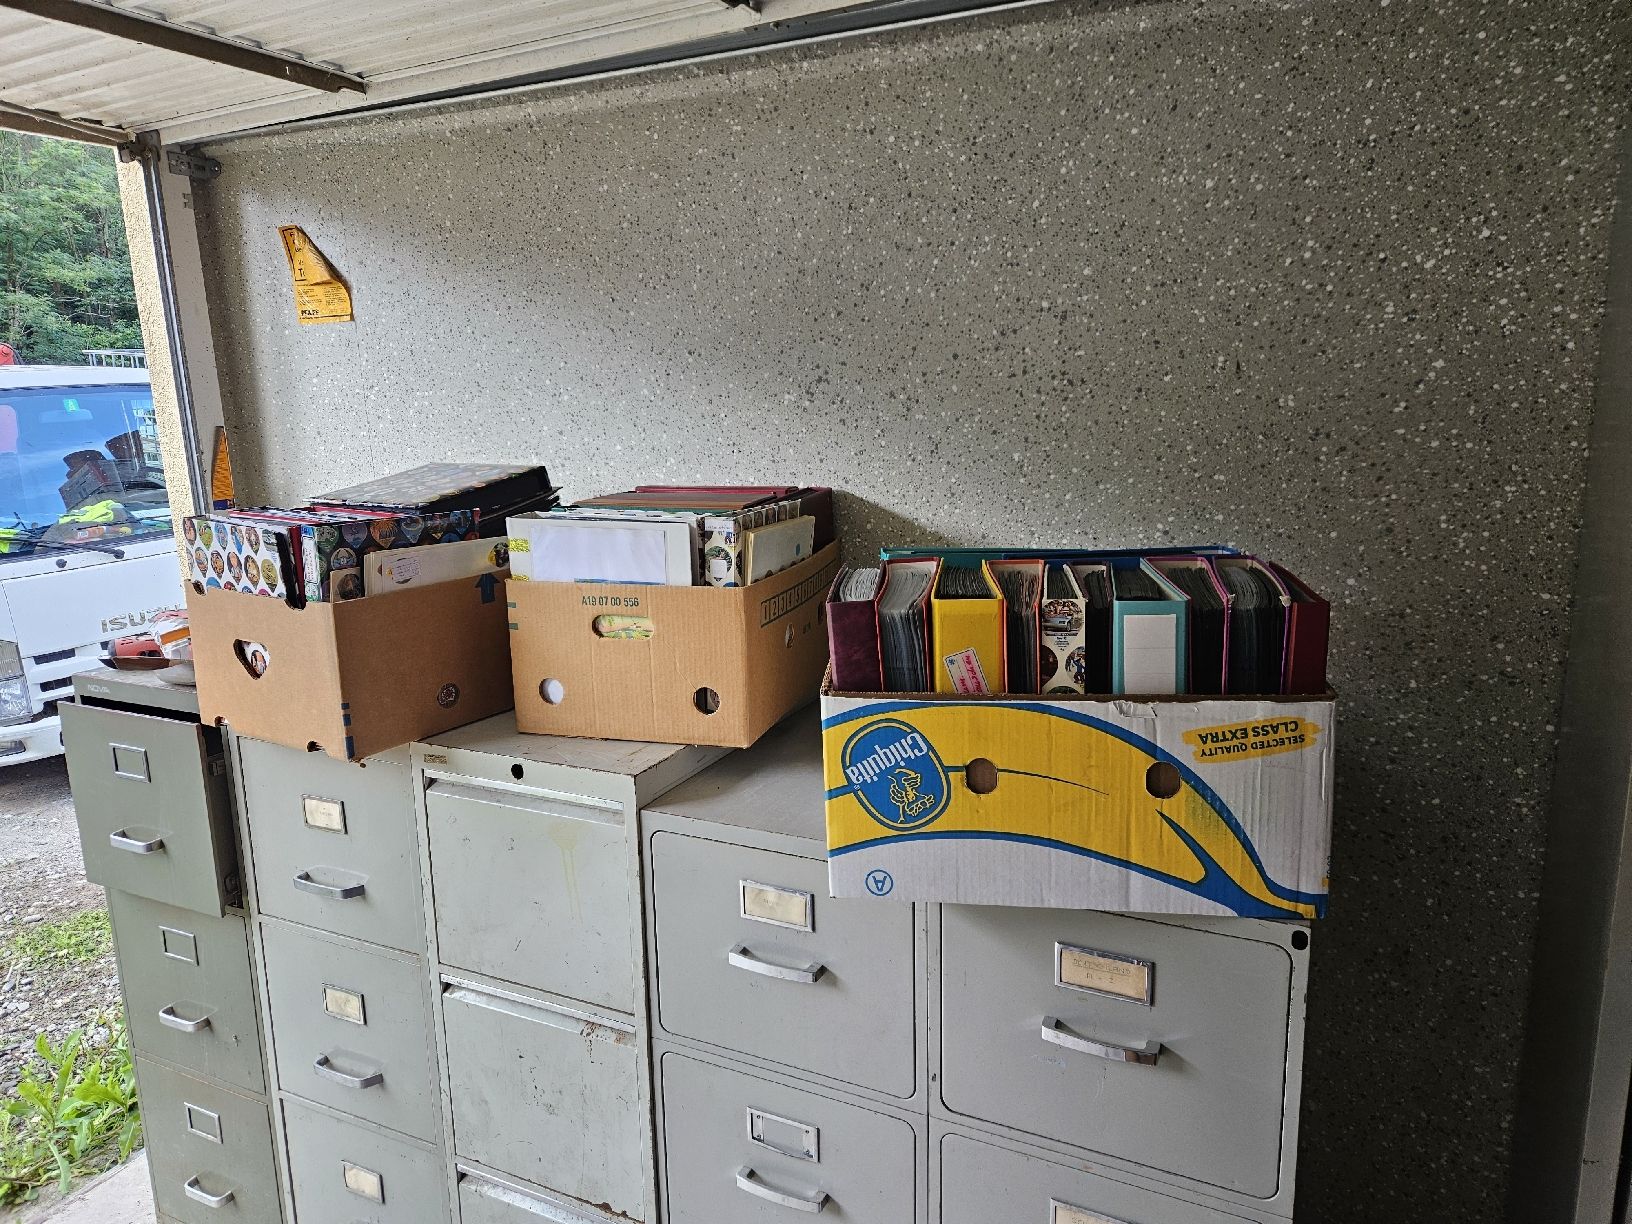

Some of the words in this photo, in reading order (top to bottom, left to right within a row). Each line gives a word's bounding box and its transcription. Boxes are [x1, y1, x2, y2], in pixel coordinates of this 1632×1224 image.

[582, 596, 596, 606] A19
[599, 596, 608, 606] 07
[610, 596, 621, 606] 00
[623, 597, 640, 607] 556
[87, 684, 111, 694] NOVA
[1198, 727, 1249, 745] EXTRA
[1251, 720, 1299, 737] CLASS
[1200, 742, 1248, 758] QUALITY
[1250, 734, 1305, 750] SELECTED
[845, 732, 928, 785] Chiquita
